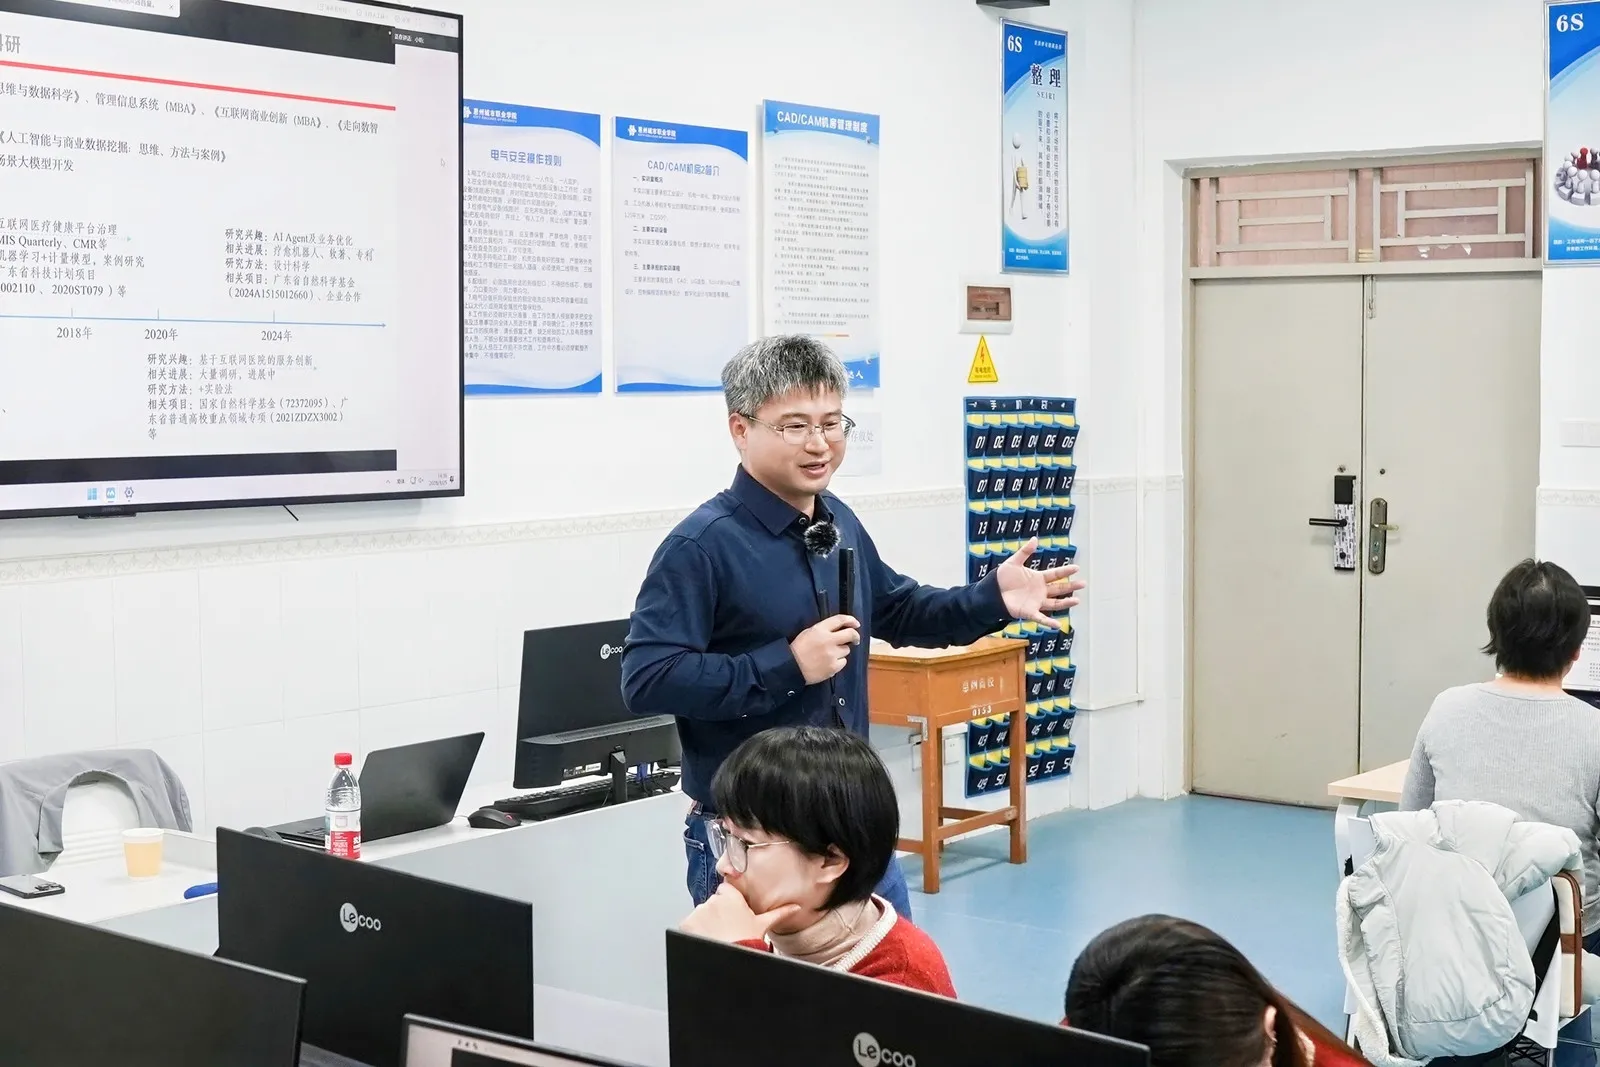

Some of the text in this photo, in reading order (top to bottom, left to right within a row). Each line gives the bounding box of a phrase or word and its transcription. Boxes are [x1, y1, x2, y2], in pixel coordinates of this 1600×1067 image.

[1556, 13, 1585, 33] 6S
[0, 34, 20, 54] 研
[1007, 34, 1023, 53] 6S
[1036, 91, 1056, 101] SEIRI
[776, 110, 868, 134] CAD/CAM机房管理制度
[490, 149, 562, 167] 电气安全操作规则
[56, 326, 293, 343] 2018年 2020年 2024年
[147, 428, 157, 441] 等
[975, 434, 1075, 449] 01 02 03 04 05 06
[977, 476, 1072, 493] 07 08 09 10 11 12
[978, 516, 1072, 535] 13 14 15 16 17 18
[978, 564, 988, 577] 19
[600, 643, 623, 660] Lecoo
[1029, 637, 1072, 655] 34 35 36
[1032, 677, 1074, 695] 40 41 42
[972, 705, 992, 716] 0153
[978, 717, 1073, 747] 43 44 46 47 48
[977, 757, 1073, 790] 49 50 52 53 54
[340, 903, 381, 932] Lecoo
[853, 1032, 916, 1067] Lecoo
